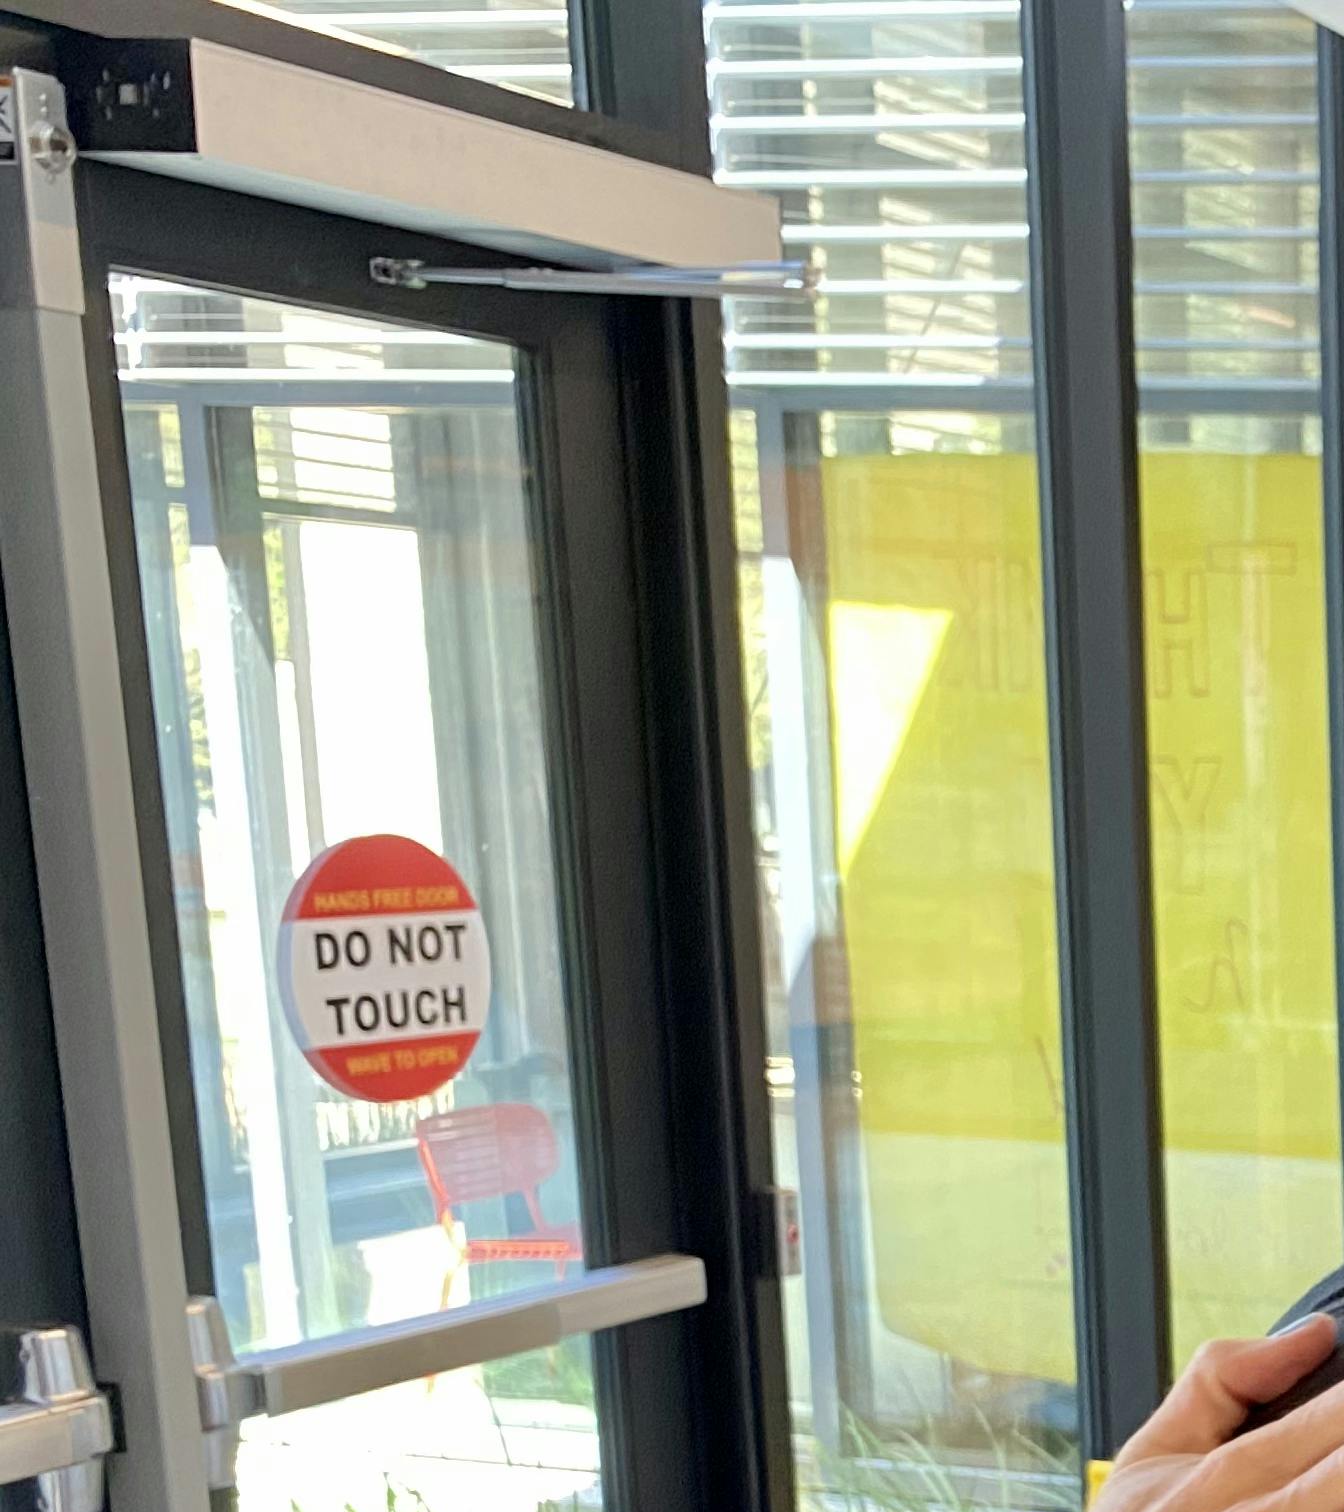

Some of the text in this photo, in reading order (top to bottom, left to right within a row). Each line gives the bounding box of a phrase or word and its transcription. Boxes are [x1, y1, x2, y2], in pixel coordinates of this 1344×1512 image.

[373, 887, 411, 908] FREE
[315, 925, 467, 971] DO NOT
[326, 985, 468, 1036] TOUCH
[394, 1049, 416, 1071] TO
